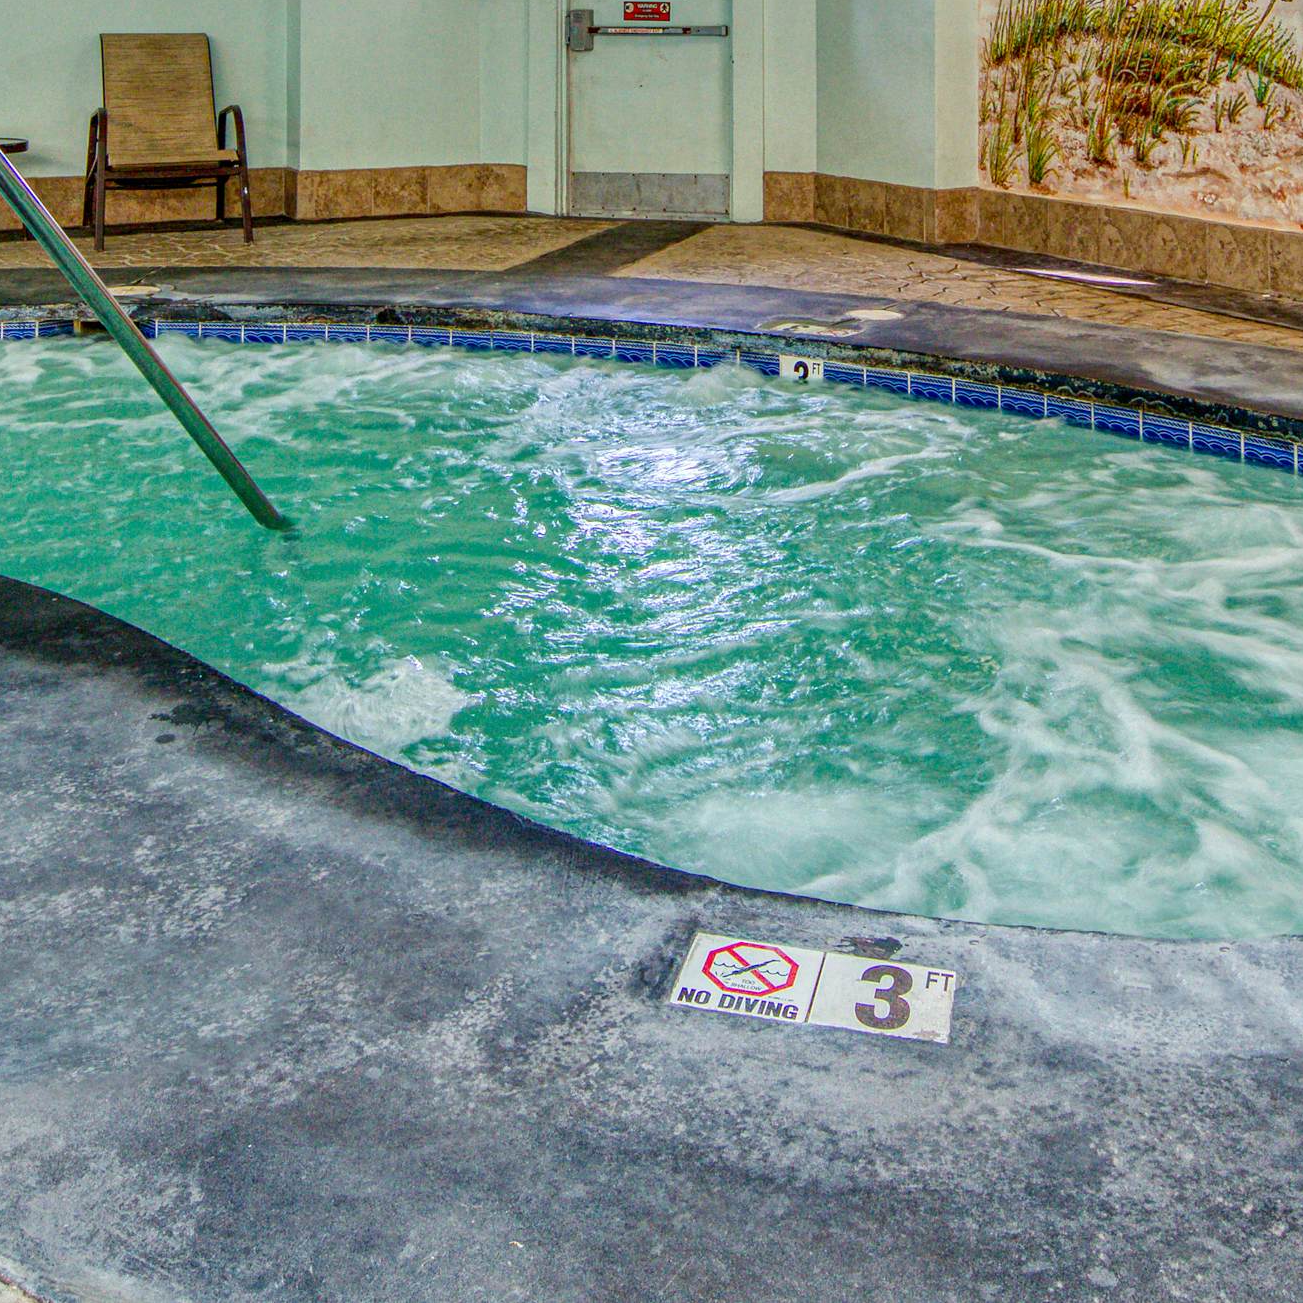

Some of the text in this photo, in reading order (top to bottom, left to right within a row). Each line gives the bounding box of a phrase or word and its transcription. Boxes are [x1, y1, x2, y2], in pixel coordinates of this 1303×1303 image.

[812, 363, 820, 375] FT
[730, 982, 763, 991] SHALLOW
[854, 964, 954, 1030] 3 FT
[677, 987, 799, 1020] NO DIVING
